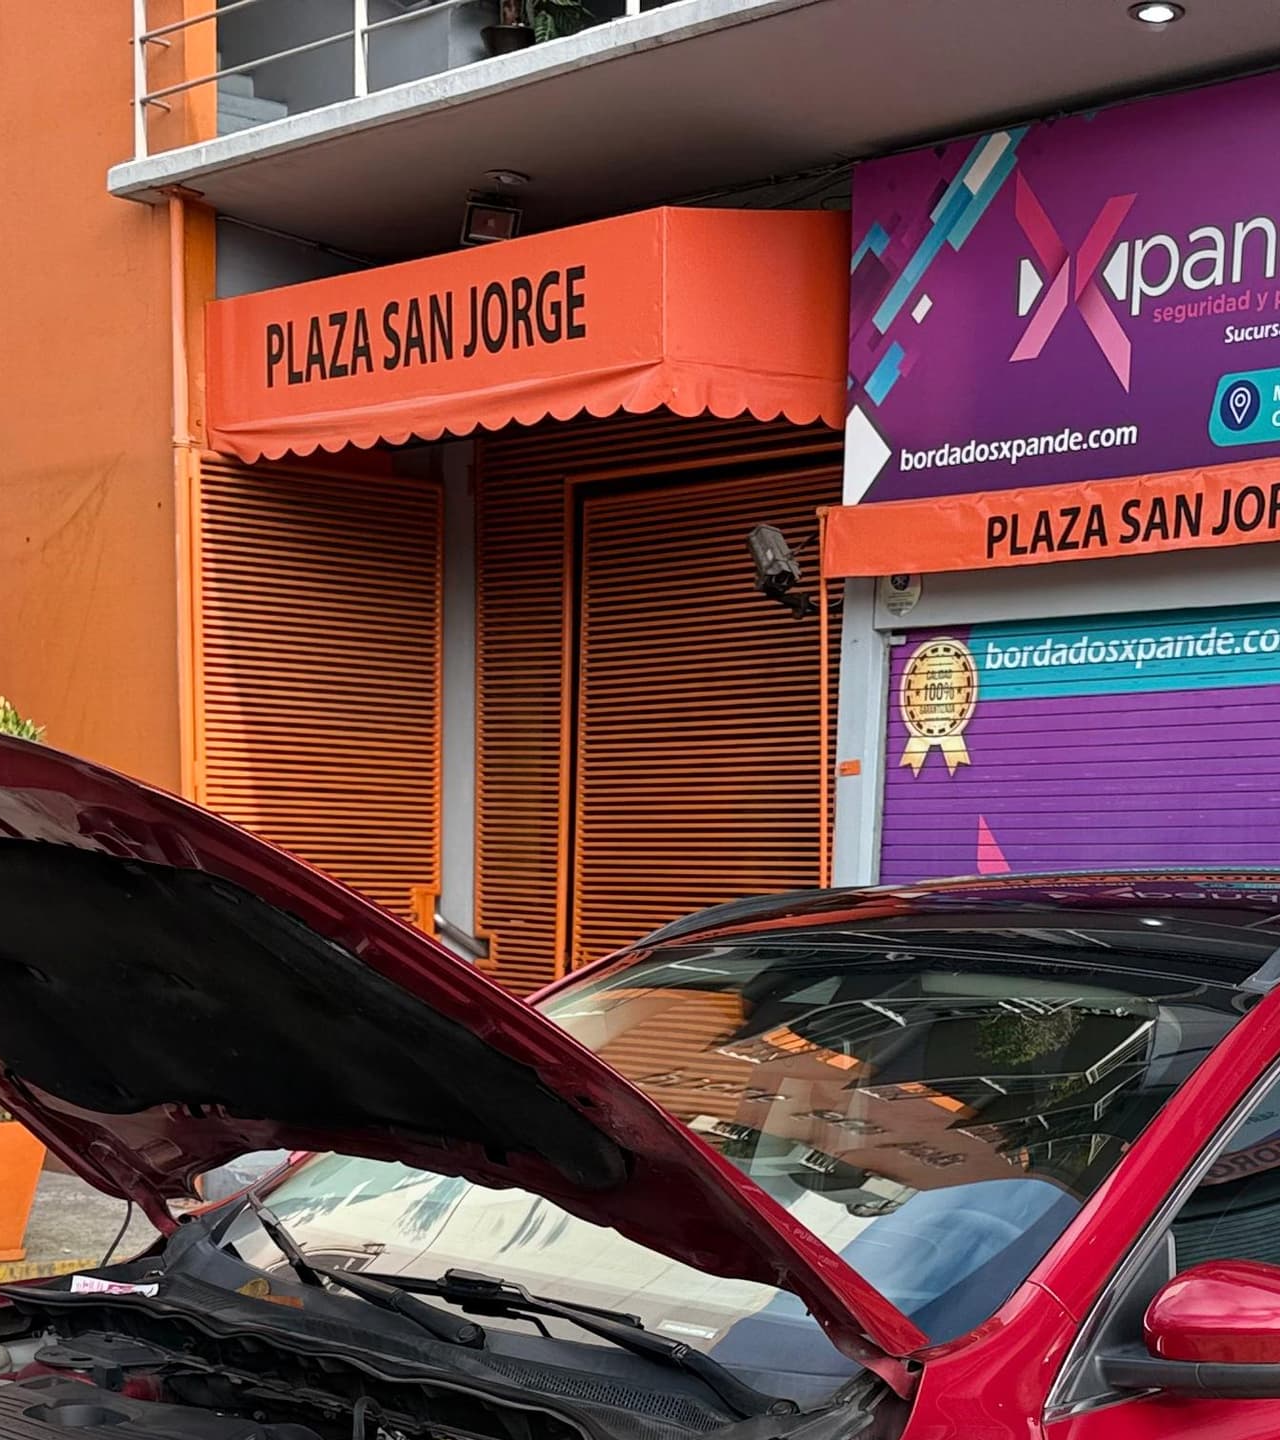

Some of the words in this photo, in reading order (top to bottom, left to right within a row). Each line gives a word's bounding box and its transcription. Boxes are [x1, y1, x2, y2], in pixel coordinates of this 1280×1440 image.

[267, 308, 374, 388] PLAZA
[382, 292, 453, 371] SAN
[462, 265, 587, 358] JORGE
[1152, 294, 1251, 324] seguridad
[1256, 290, 1268, 313] y
[899, 421, 1139, 473] bordadosxpande.com
[985, 506, 1107, 560] PLAZA
[1119, 492, 1205, 546] SAN
